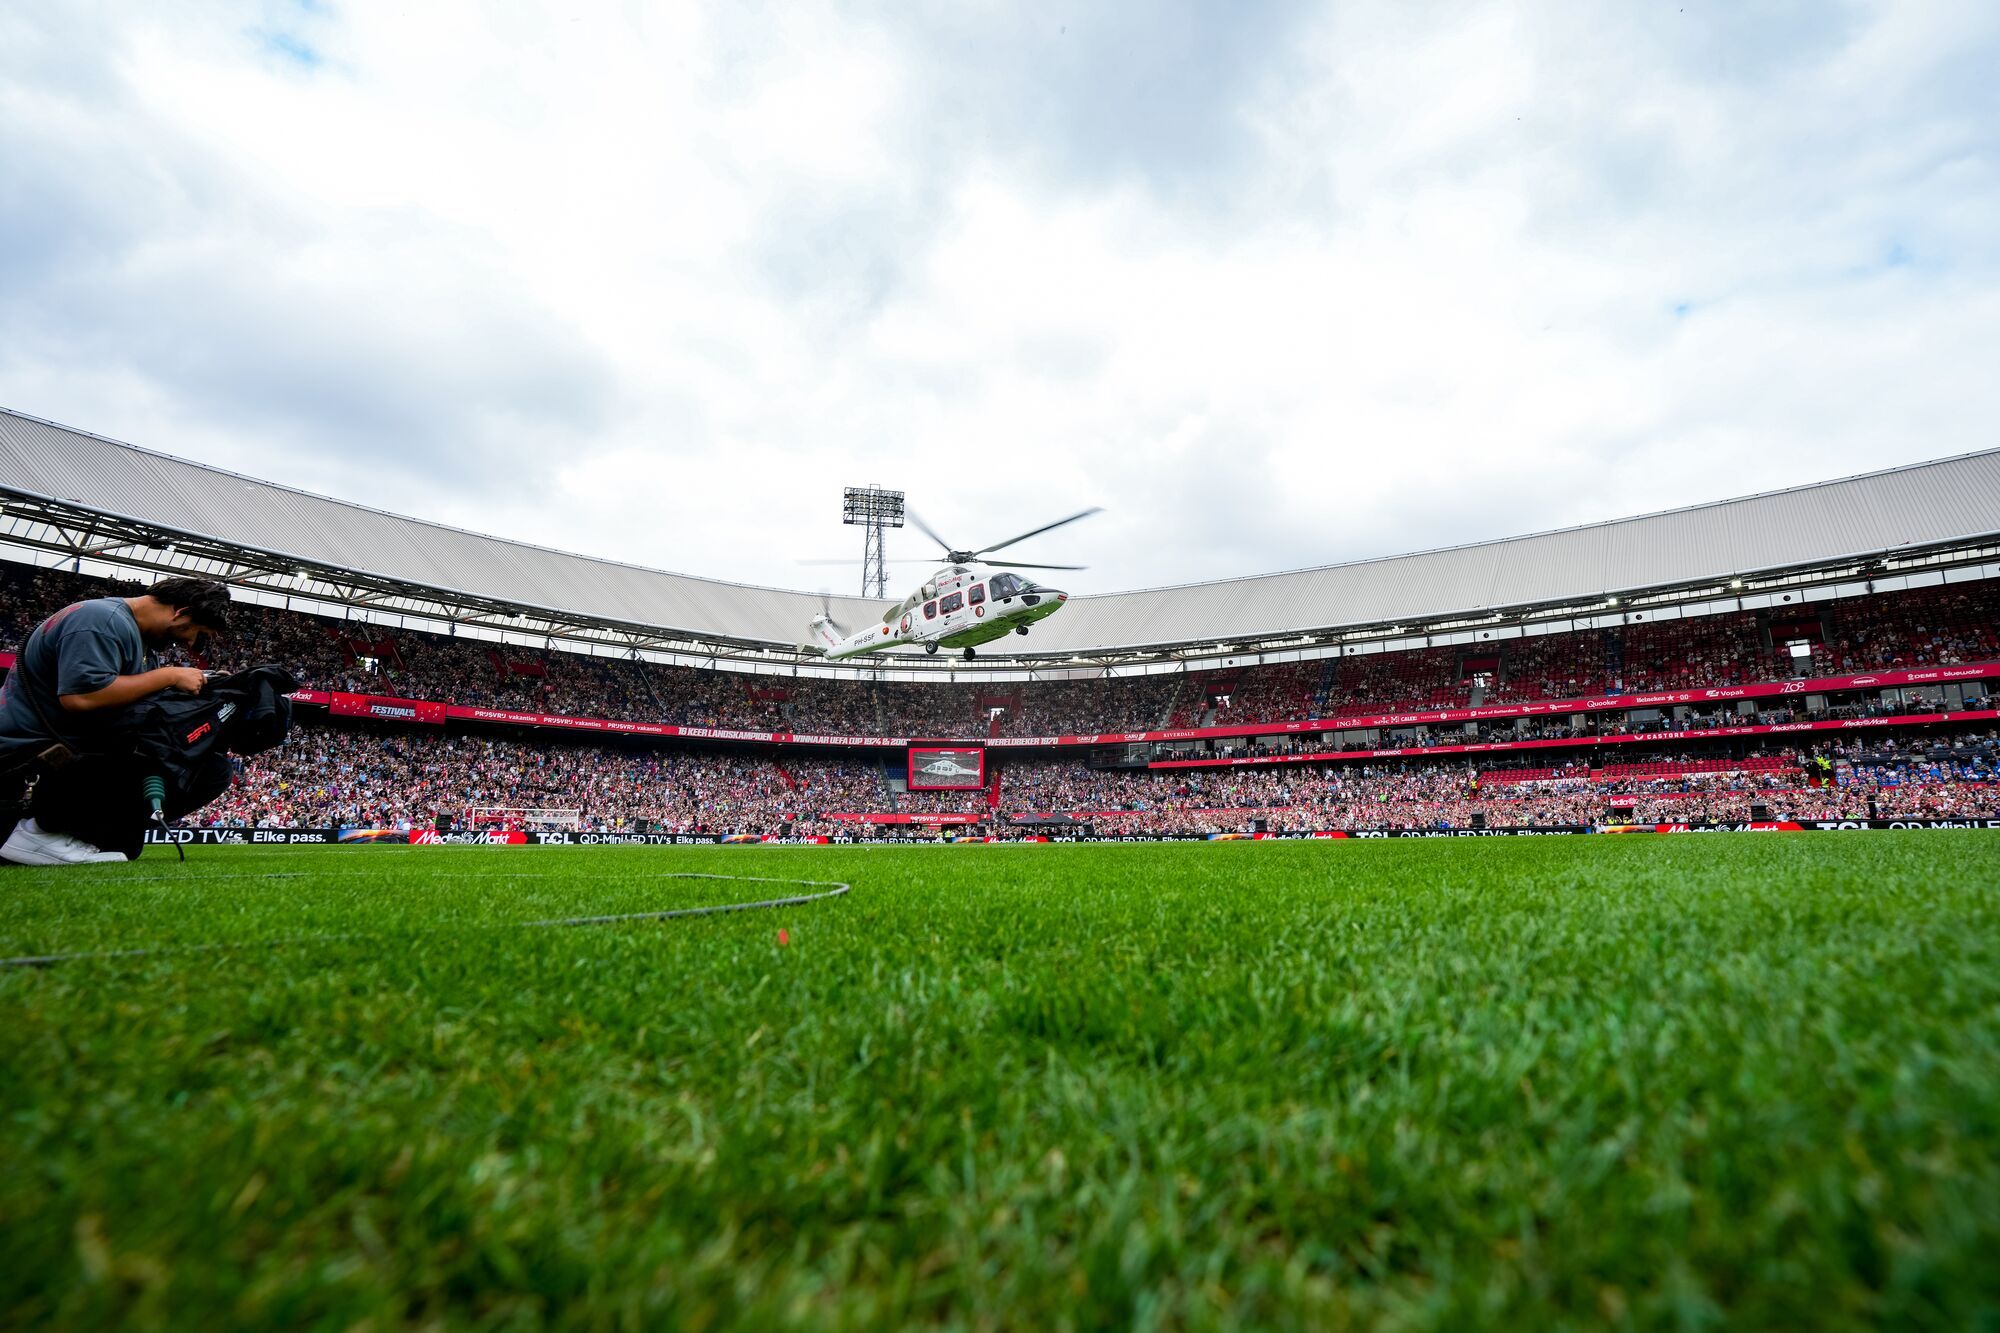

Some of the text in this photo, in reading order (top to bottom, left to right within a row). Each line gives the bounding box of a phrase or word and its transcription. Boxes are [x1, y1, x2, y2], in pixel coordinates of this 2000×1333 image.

[1943, 669, 1984, 677] bluewater
[1586, 700, 1618, 708] Quooker
[508, 714, 537, 722] vakanties
[575, 720, 602, 728] vakanties
[687, 727, 708, 737] KEER
[707, 729, 773, 741] LANDSKAMPIOEN
[1646, 732, 1684, 740] CASTORE
[792, 734, 830, 744] WINNAAR
[829, 736, 849, 745] UEFA
[848, 737, 863, 745] CUP
[987, 738, 1040, 746] WERELDBEKER
[253, 830, 286, 843] Elke
[290, 833, 327, 844] pass.
[536, 833, 574, 844] TCL
[676, 835, 694, 844] Elke
